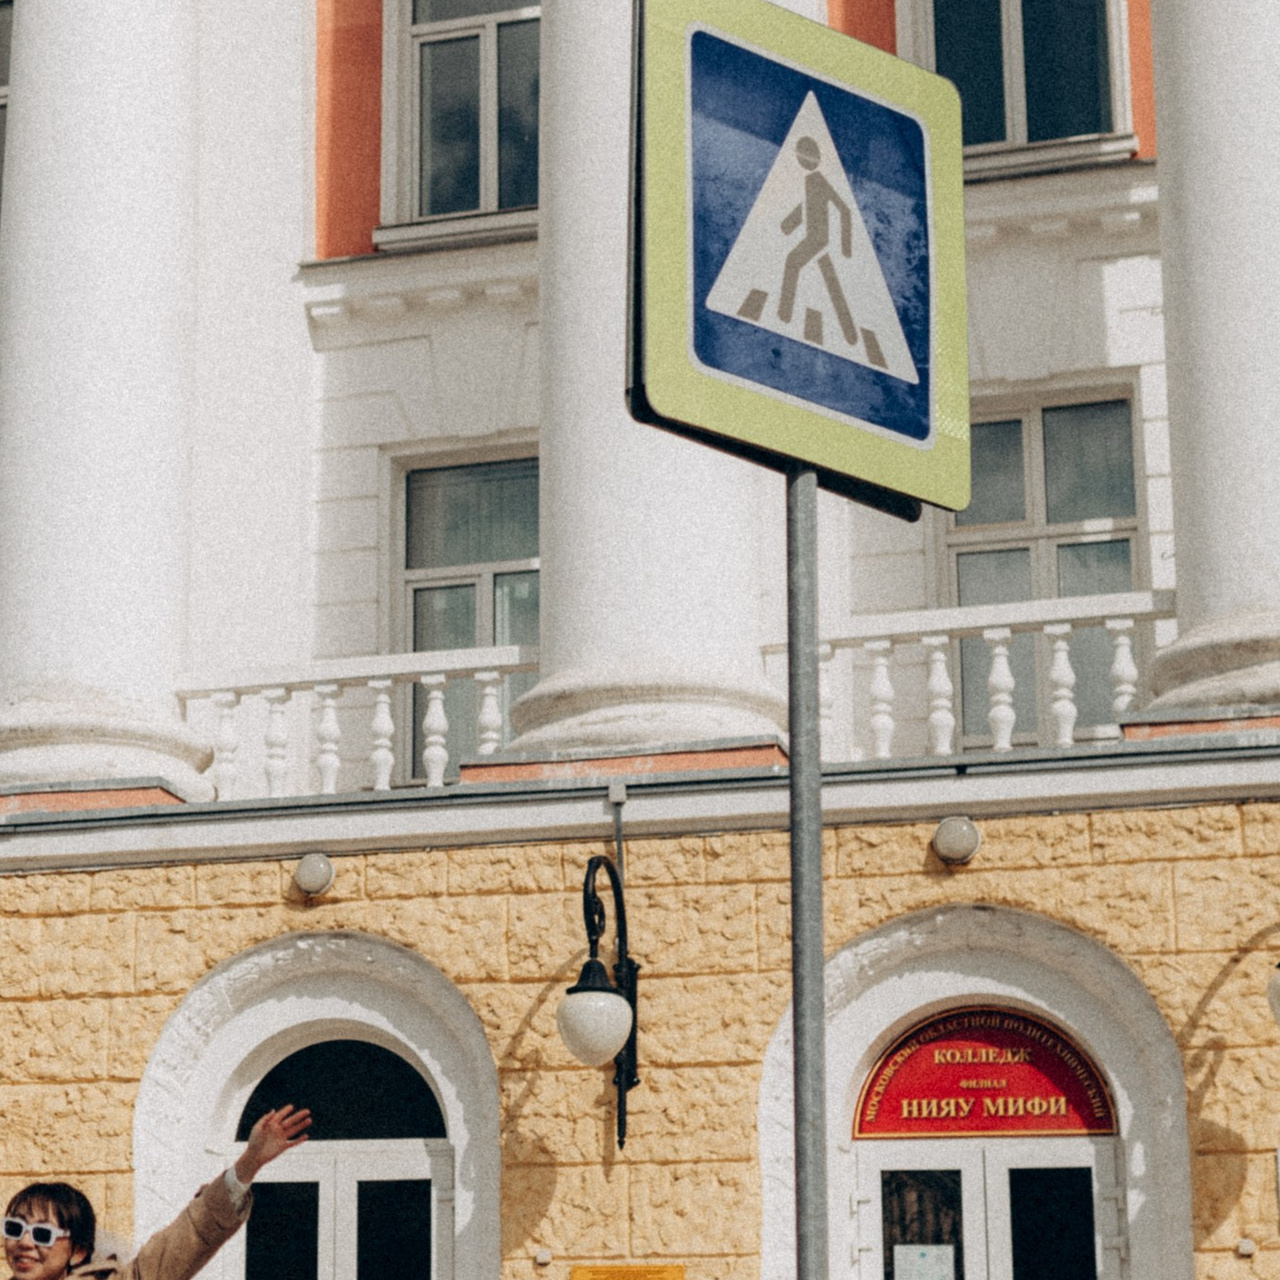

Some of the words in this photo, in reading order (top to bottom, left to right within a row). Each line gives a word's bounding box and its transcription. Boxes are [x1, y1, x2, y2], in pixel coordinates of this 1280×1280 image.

[933, 1047, 1032, 1065] КОЛЛЕДЖ
[865, 1038, 923, 1123] МОСКОВСКИЙ
[900, 1097, 974, 1119] НИЯУ
[982, 1095, 1068, 1117] МИФИ
